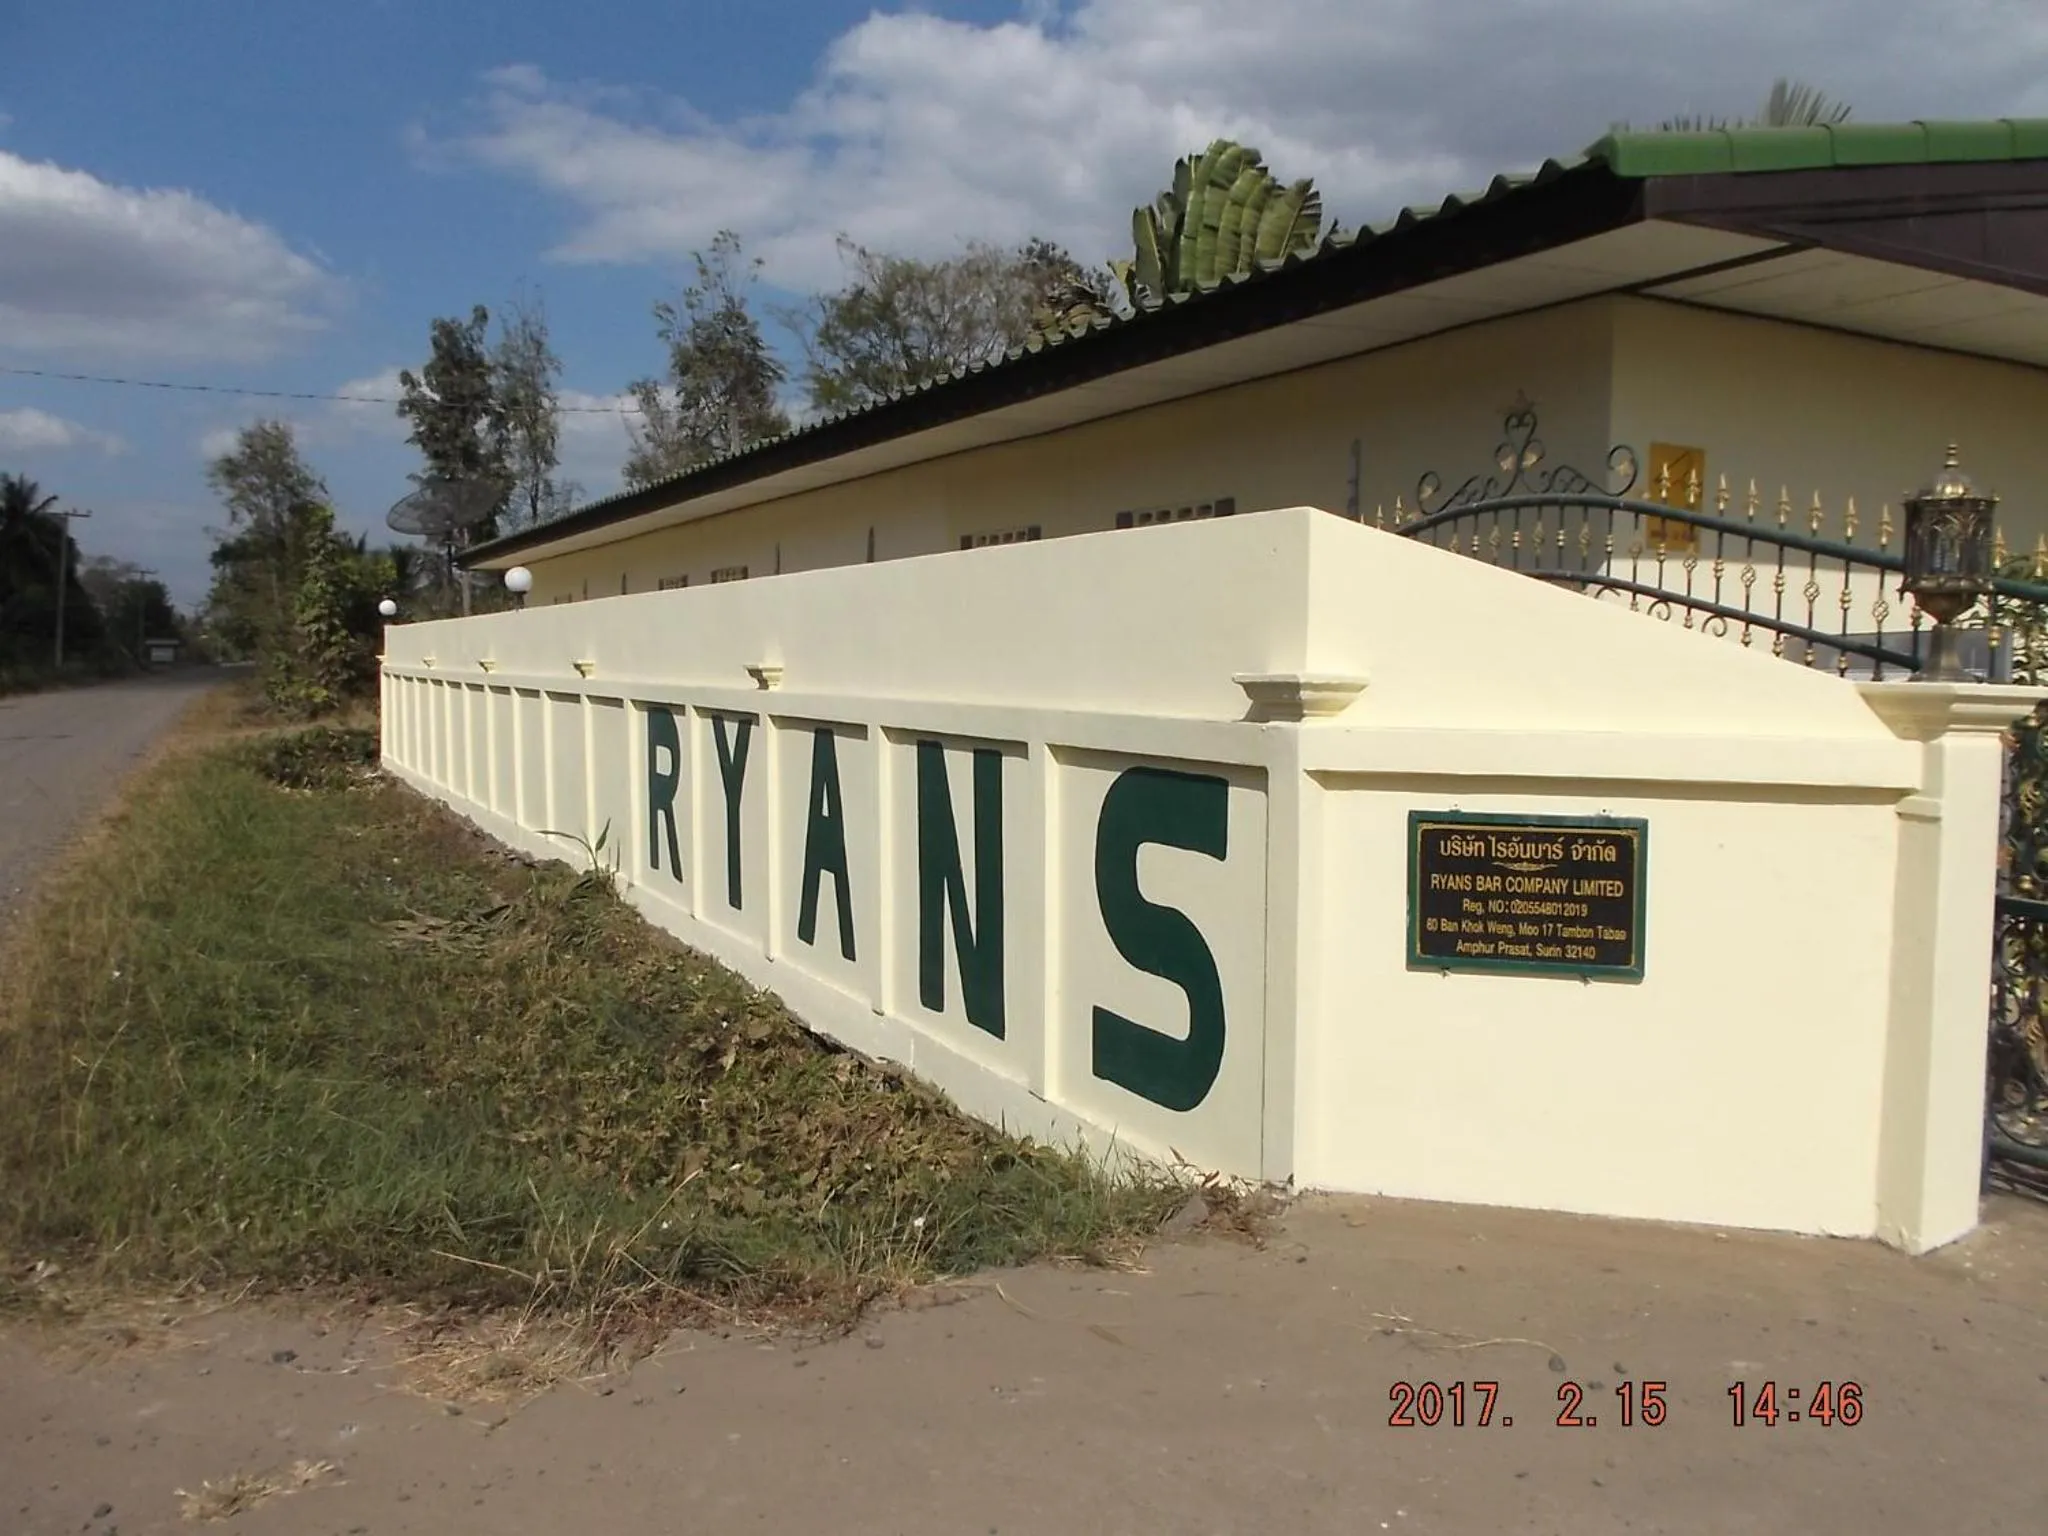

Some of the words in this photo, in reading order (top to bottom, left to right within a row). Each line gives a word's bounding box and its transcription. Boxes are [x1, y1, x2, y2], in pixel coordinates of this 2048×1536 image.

[1439, 834, 1485, 857] บริษัท
[1488, 835, 1564, 861] ไรอันบาร์
[1570, 838, 1617, 862] จำกัด
[1430, 873, 1473, 891] RYANS
[1476, 875, 1501, 892] BAR
[1505, 877, 1569, 895] COMPANY
[1572, 879, 1624, 897] LIMITED
[647, 706, 1227, 1111] RYANS
[1463, 898, 1485, 915] Reg.
[1441, 918, 1459, 932] Ban
[1519, 922, 1539, 936] Moo
[1542, 924, 1554, 937] 17
[1556, 924, 1594, 939] Tambon
[1456, 940, 1495, 956] Amphur
[1564, 945, 1596, 960] 32140
